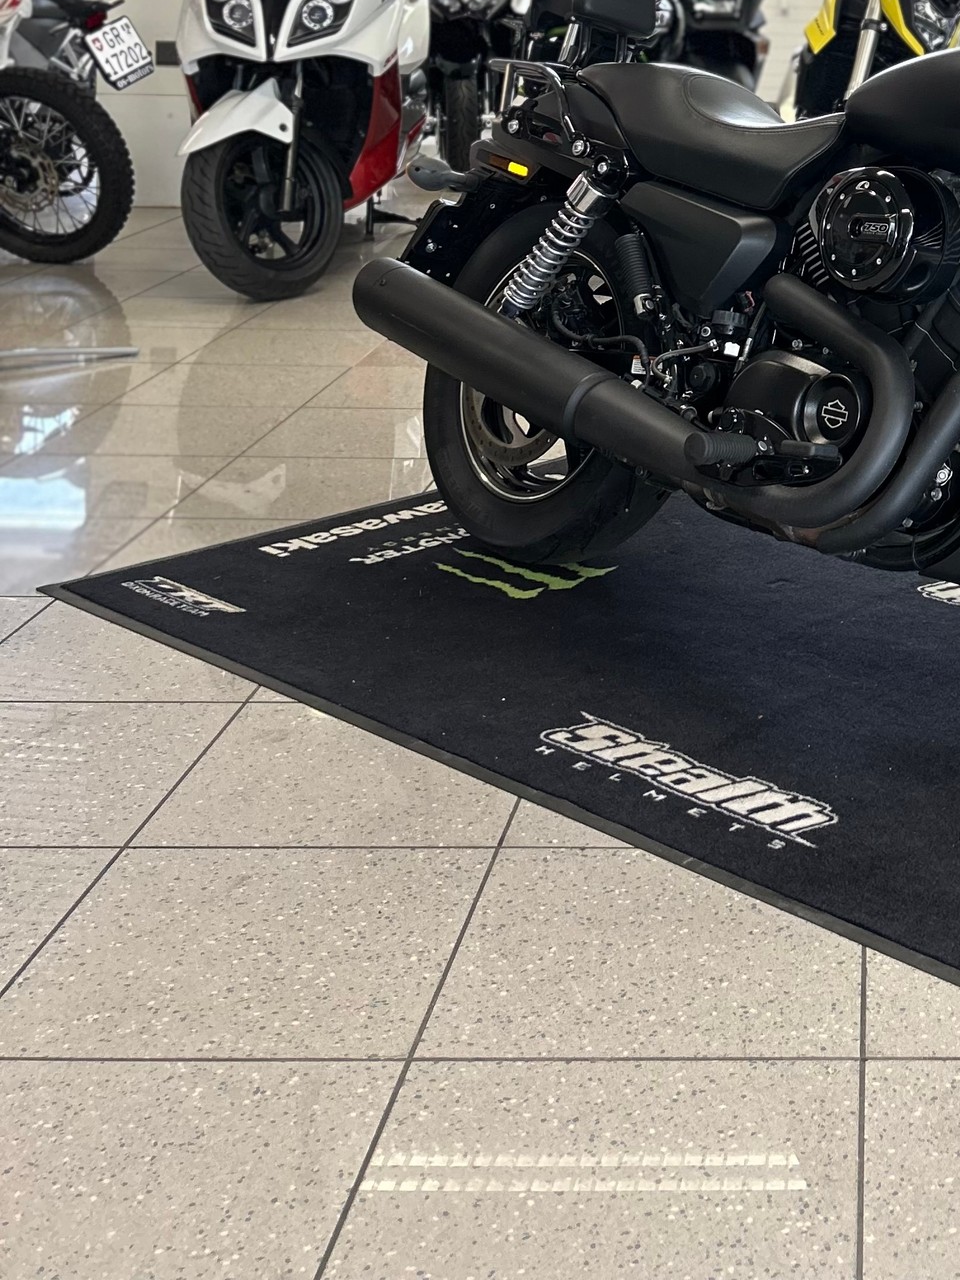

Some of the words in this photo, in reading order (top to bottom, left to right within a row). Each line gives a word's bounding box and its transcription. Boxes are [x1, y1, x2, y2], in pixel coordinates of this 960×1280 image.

[102, 26, 125, 49] GR
[105, 42, 148, 75] 17202
[864, 222, 889, 233] 750
[259, 500, 449, 557] awasaki
[534, 744, 786, 850] HELMETS
